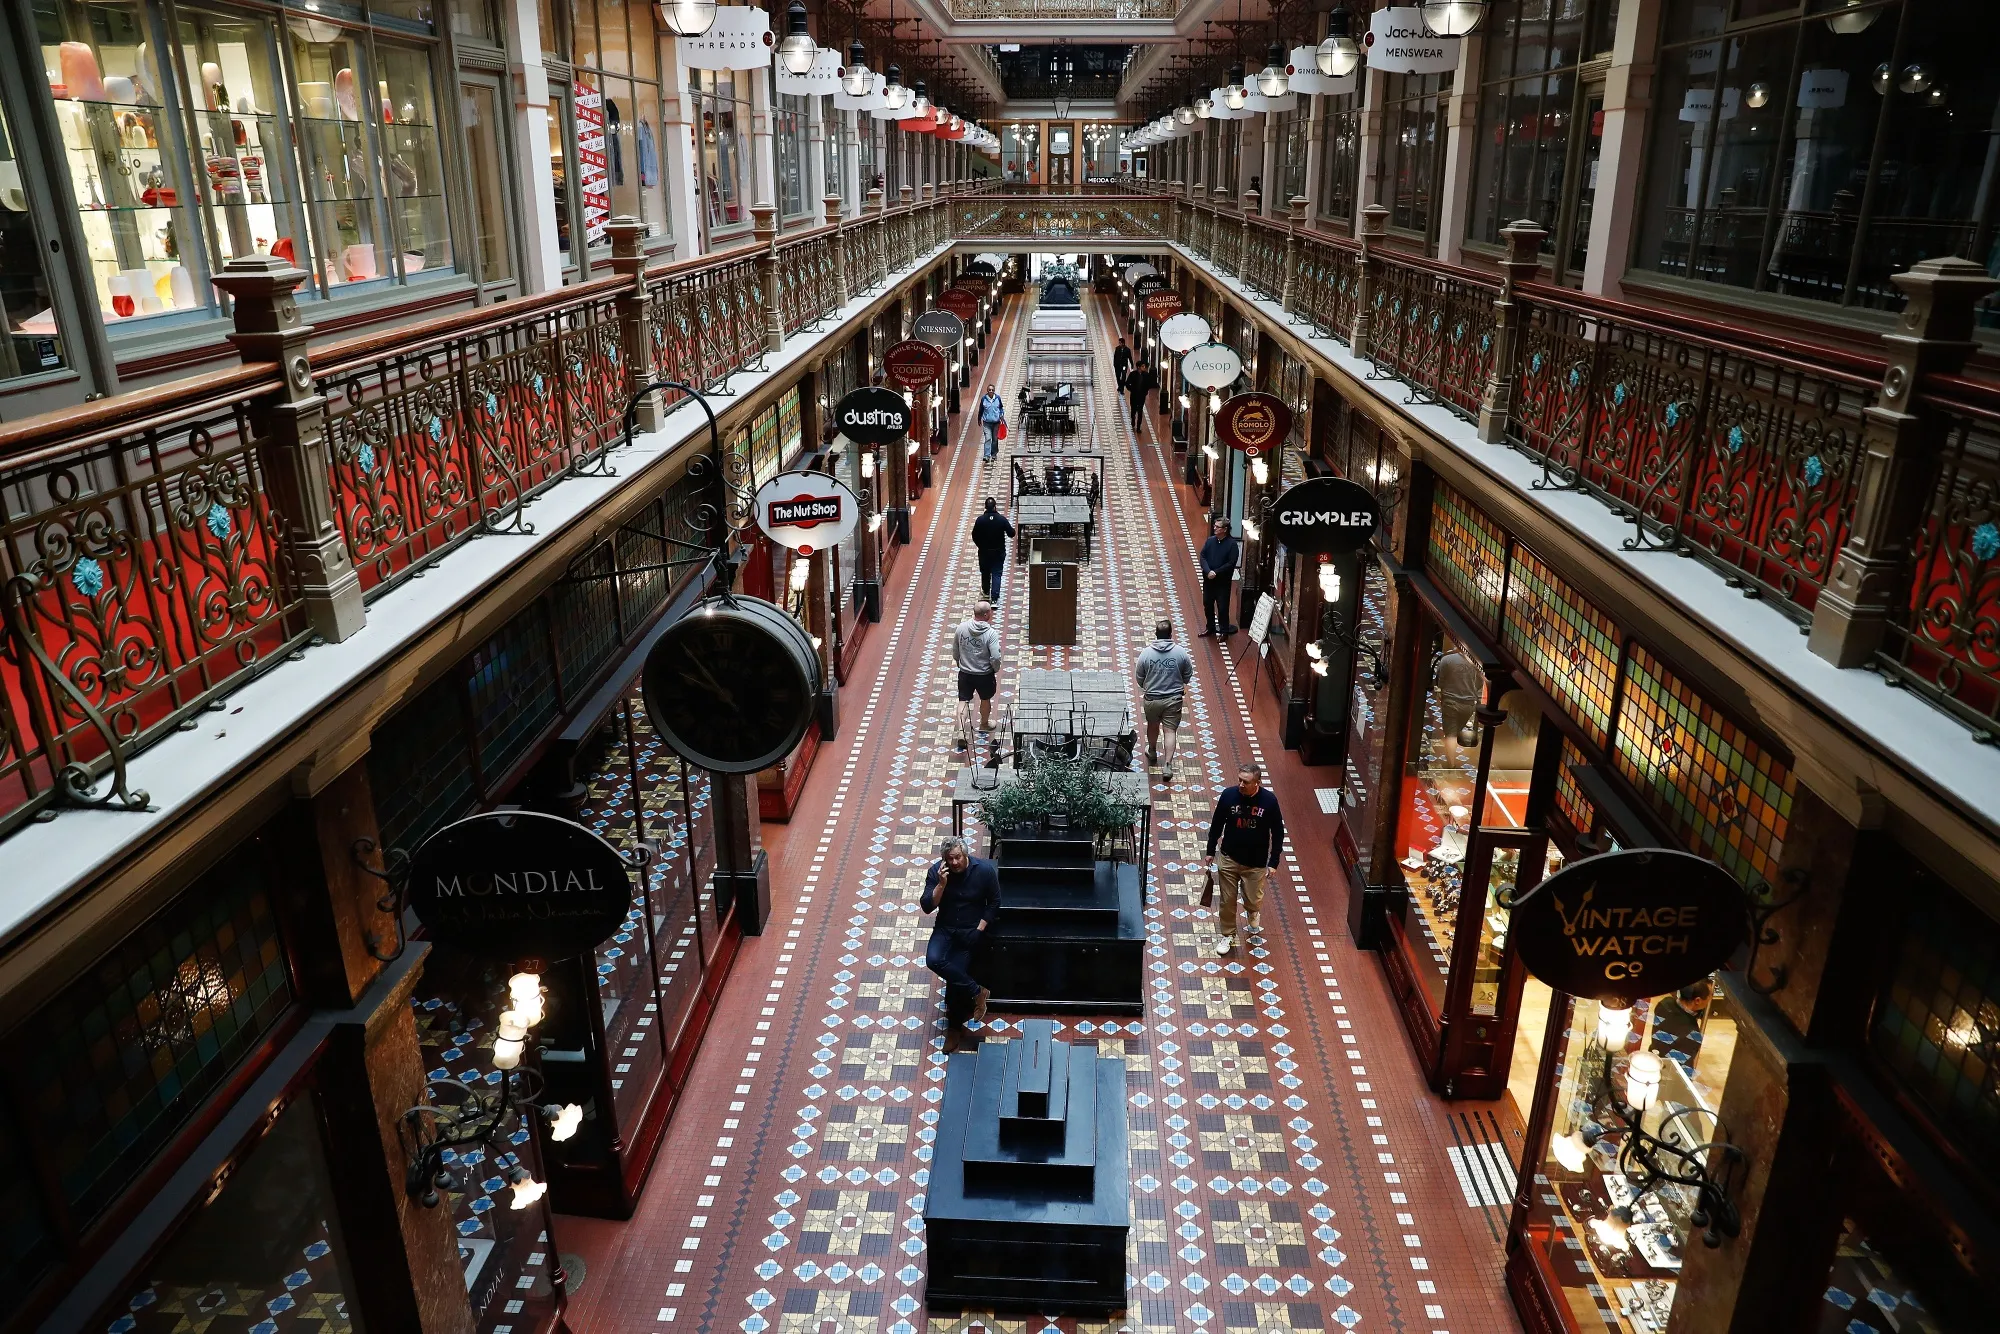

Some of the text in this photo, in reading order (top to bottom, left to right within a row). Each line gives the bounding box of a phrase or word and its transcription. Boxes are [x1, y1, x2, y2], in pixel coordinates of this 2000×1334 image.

[1386, 48, 1443, 58] MENSWEAR
[1149, 295, 1178, 303] GALLERY
[1147, 301, 1182, 309] SHOPPING
[920, 325, 957, 334] NIESSING
[892, 366, 935, 375] COOMBS
[910, 374, 932, 384] REPAIRS
[844, 409, 903, 425] dustins
[773, 502, 838, 519] The Nut Shop
[1279, 510, 1373, 527] CRUMPLER
[435, 868, 605, 898] MONDIAL
[1551, 880, 1699, 936] VINTAGE
[1571, 935, 1690, 958] WATCH
[525, 960, 540, 970] 27
[1479, 991, 1495, 1001] 28
